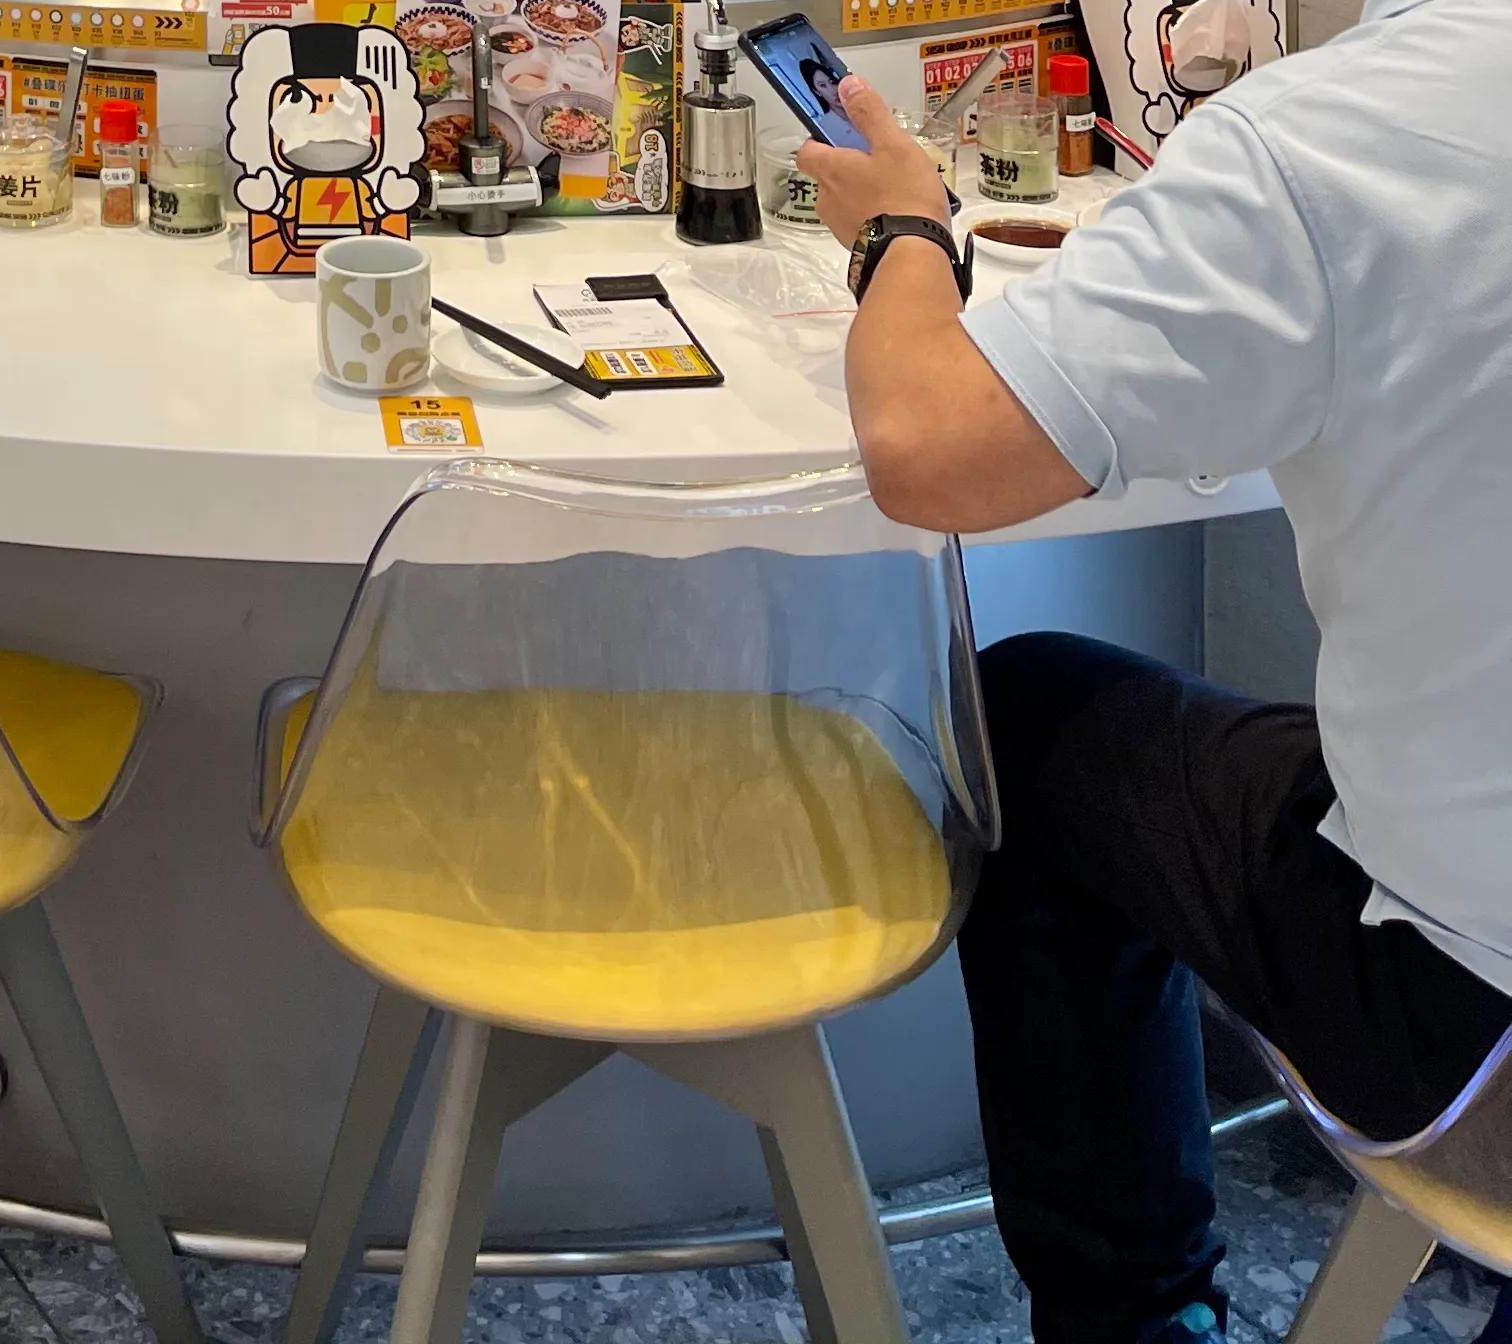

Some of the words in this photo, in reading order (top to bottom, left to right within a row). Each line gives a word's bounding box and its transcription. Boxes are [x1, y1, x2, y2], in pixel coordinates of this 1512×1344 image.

[1017, 54, 1033, 67] 06
[926, 71, 941, 84] 01
[944, 67, 961, 81] 02
[409, 399, 442, 410] 15
